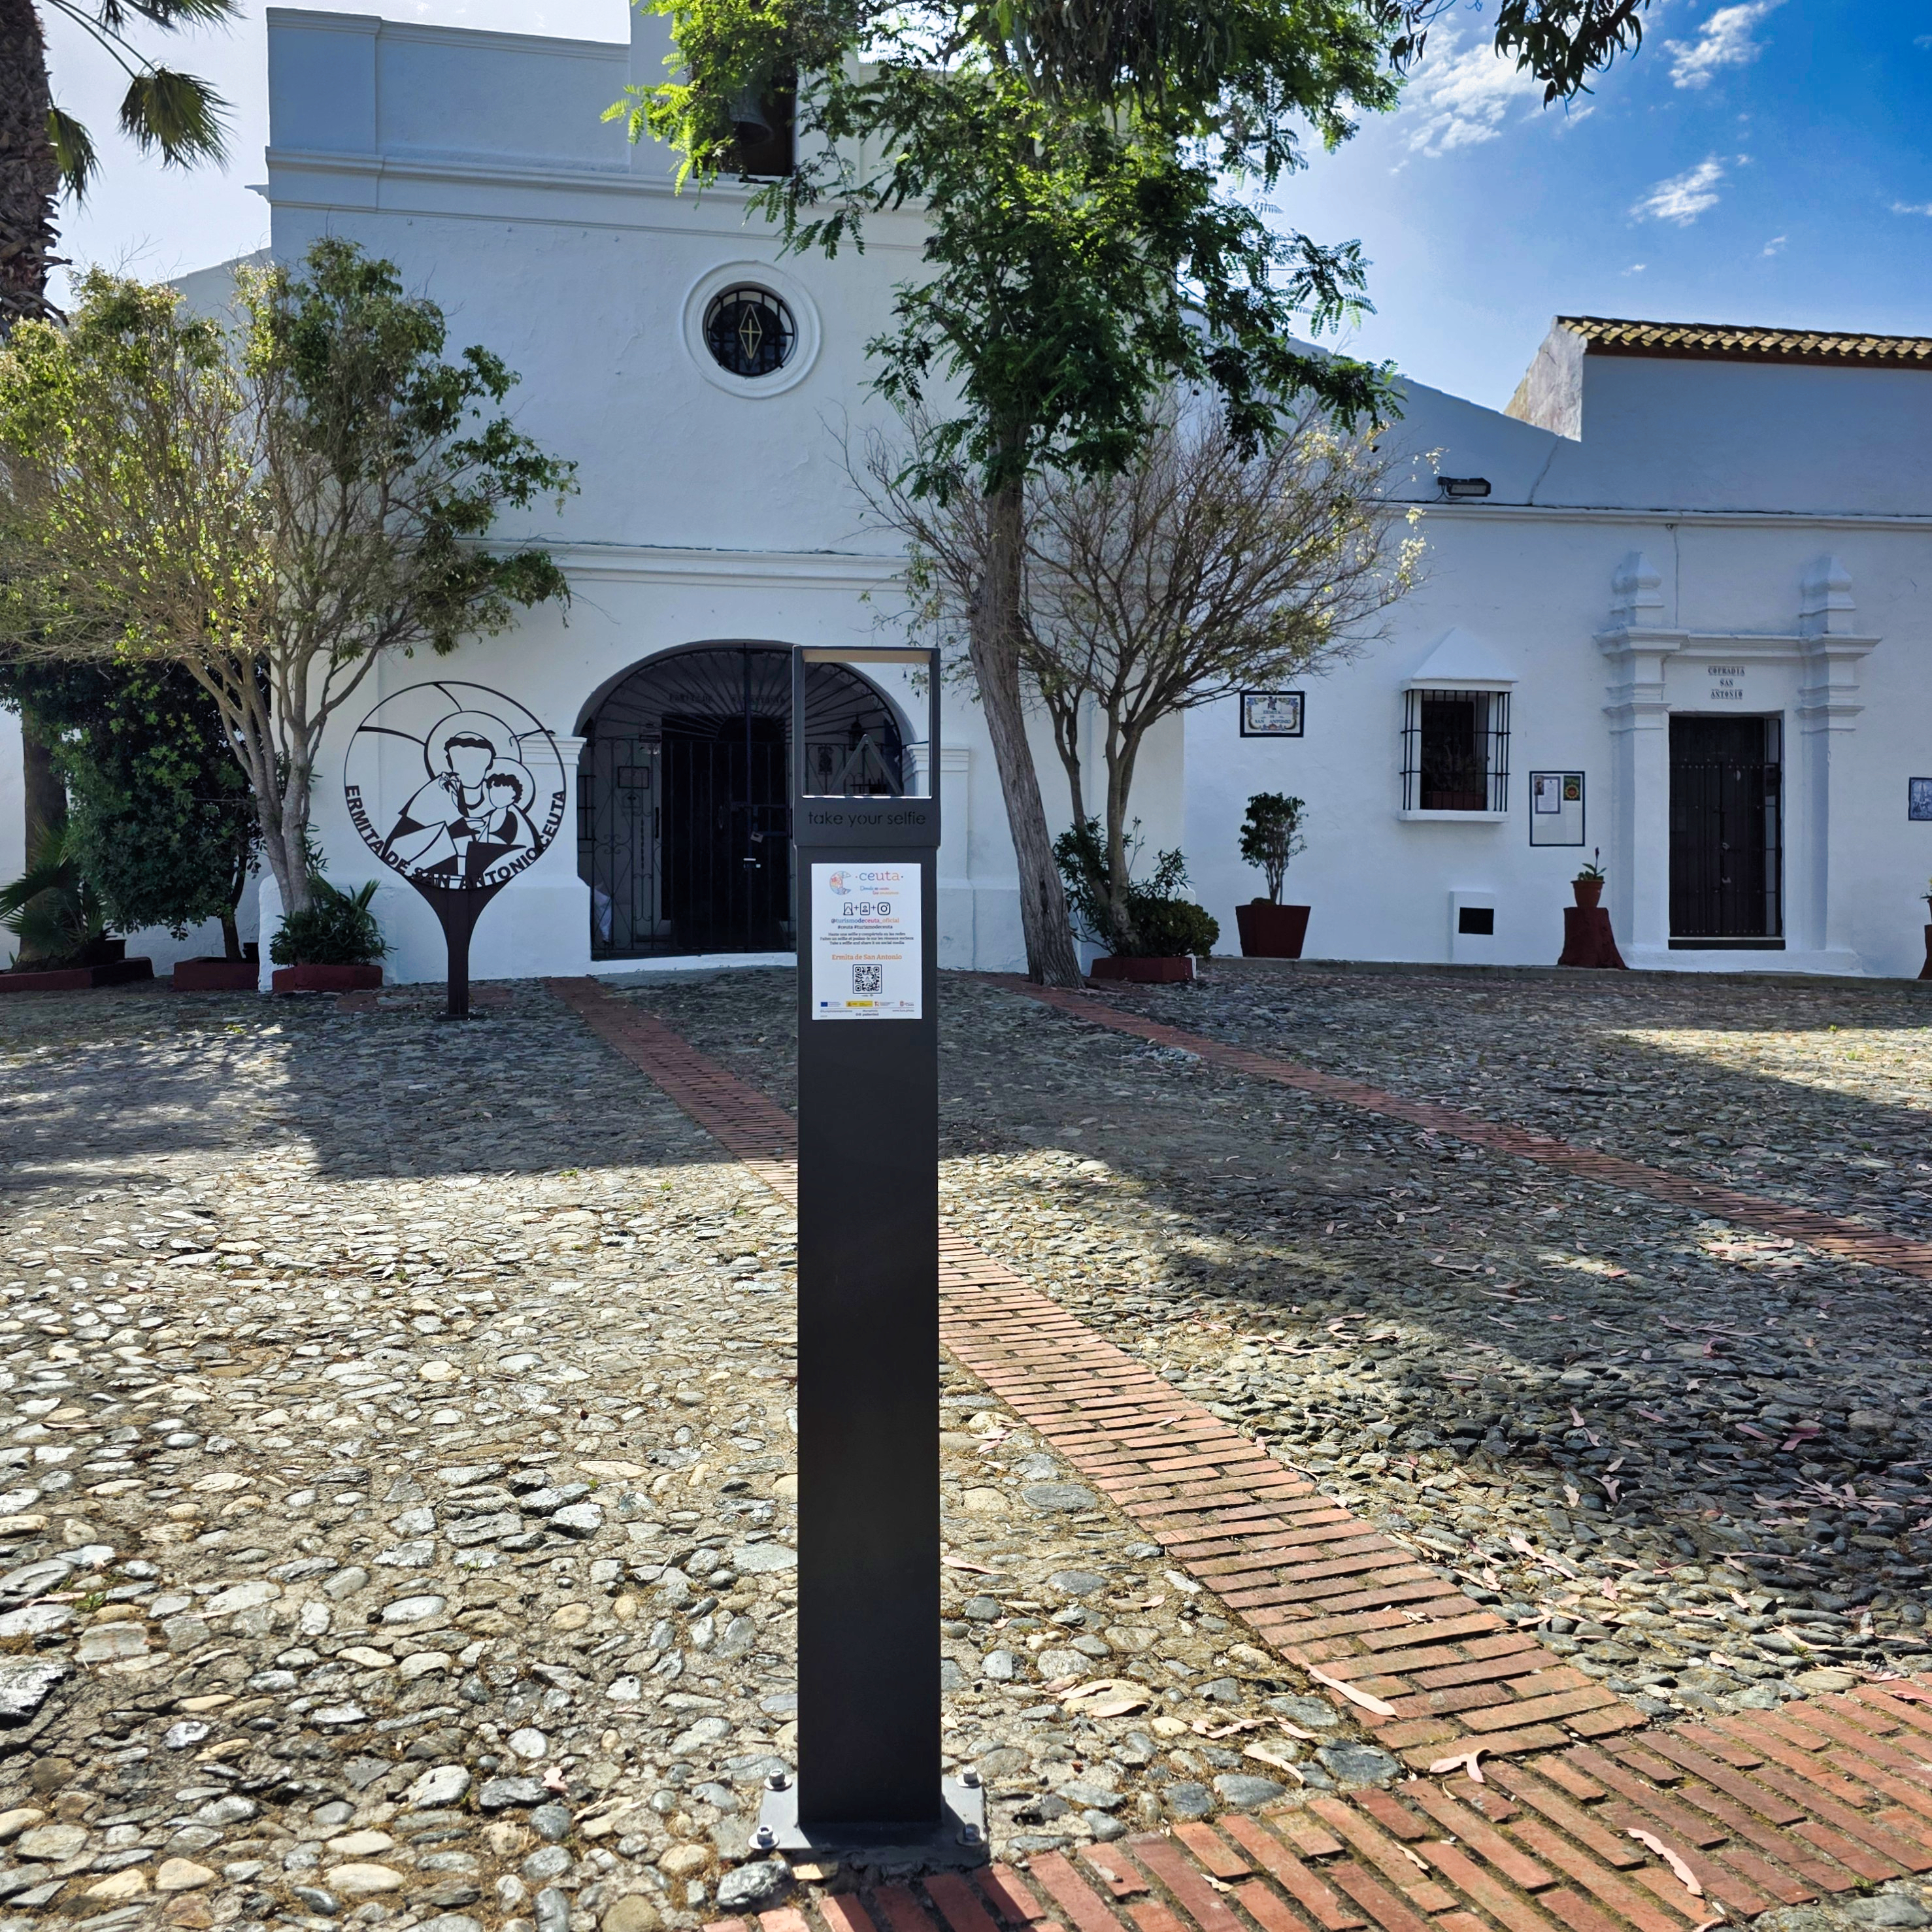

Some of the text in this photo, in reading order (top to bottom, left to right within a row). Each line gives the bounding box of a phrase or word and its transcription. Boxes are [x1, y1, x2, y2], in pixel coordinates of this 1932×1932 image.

[1708, 667, 1745, 675] COFRADIA
[1710, 690, 1743, 699] ANTONIO
[808, 811, 926, 827] take your selfie
[345, 786, 565, 889] ERMITA DE SAN ANTONIO CEUTA
